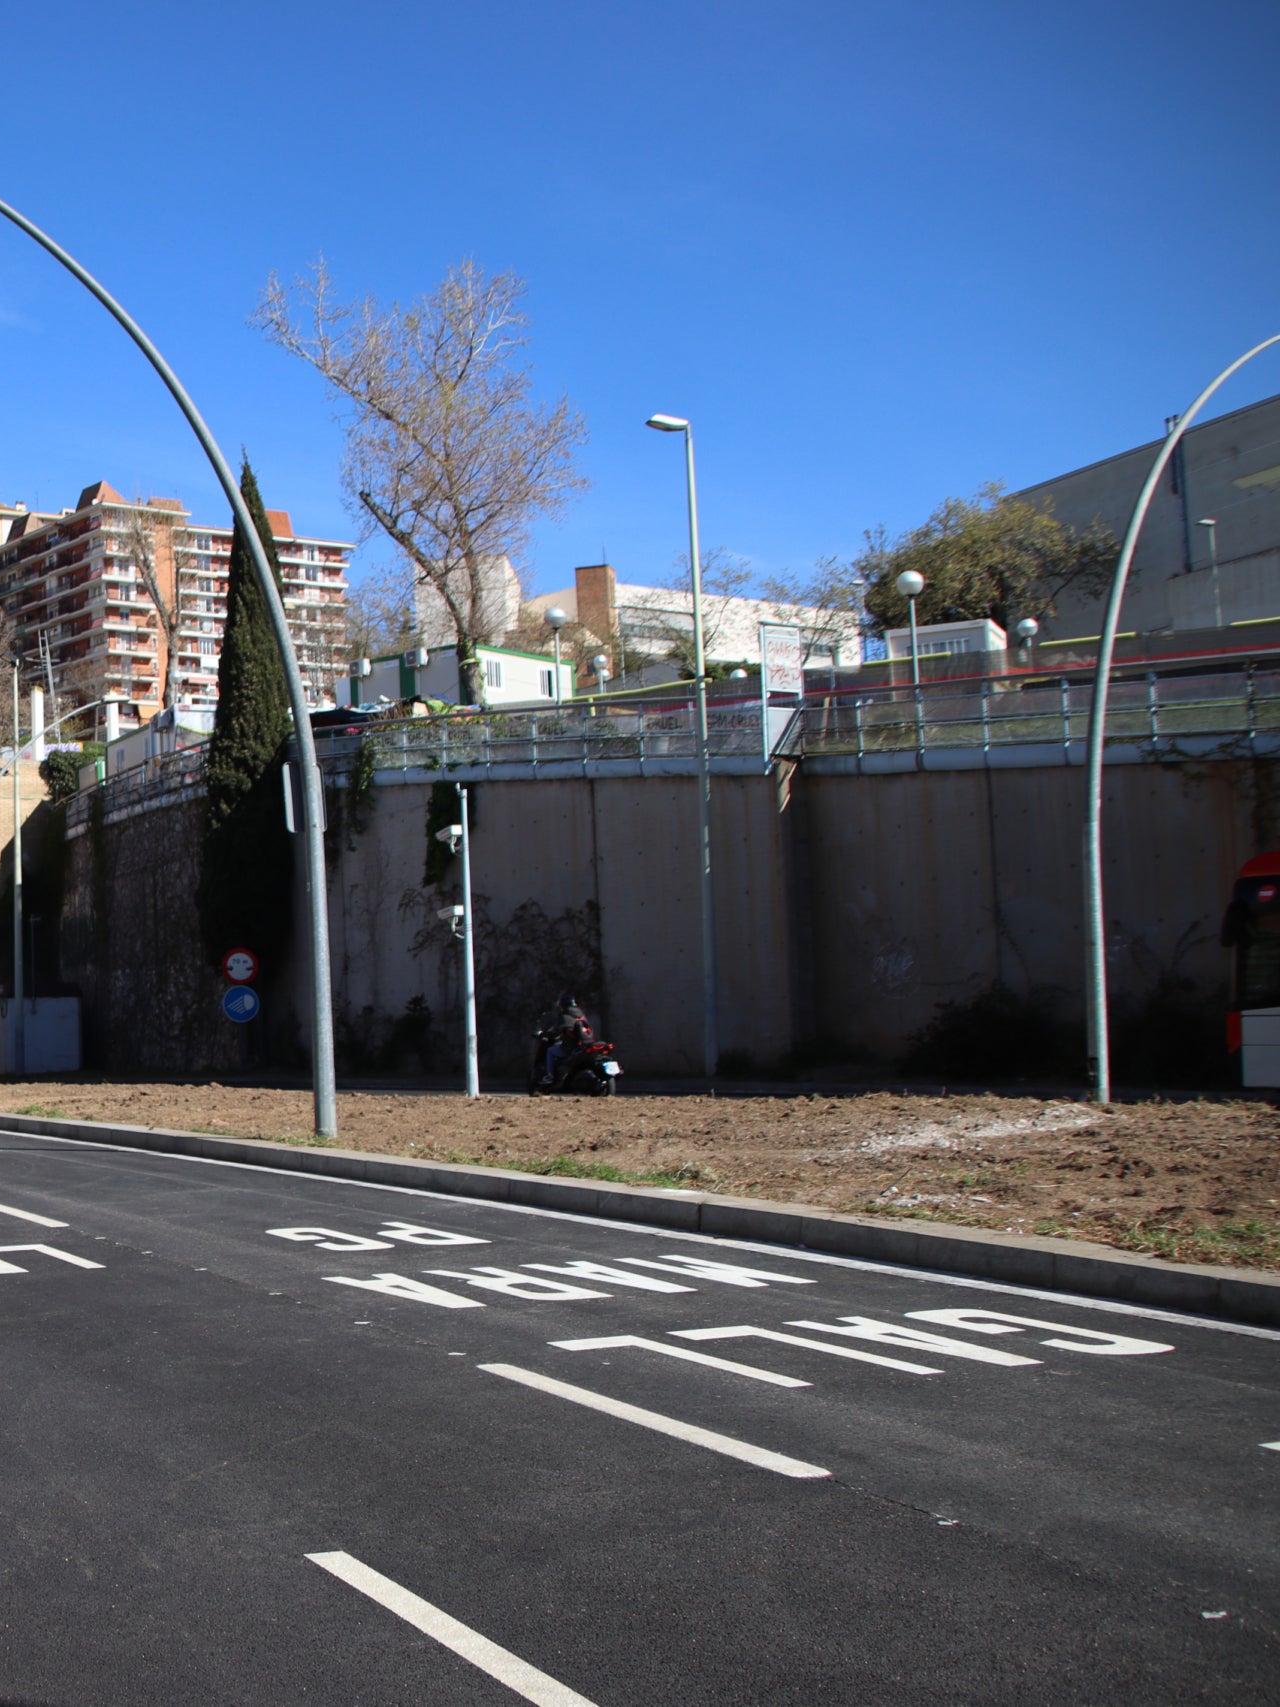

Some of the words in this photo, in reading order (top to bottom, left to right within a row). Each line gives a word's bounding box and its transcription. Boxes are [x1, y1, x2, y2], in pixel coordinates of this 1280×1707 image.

[265, 1221, 492, 1251] PG
[321, 1254, 818, 1309] MARA
[547, 1309, 1176, 1388] GALL
